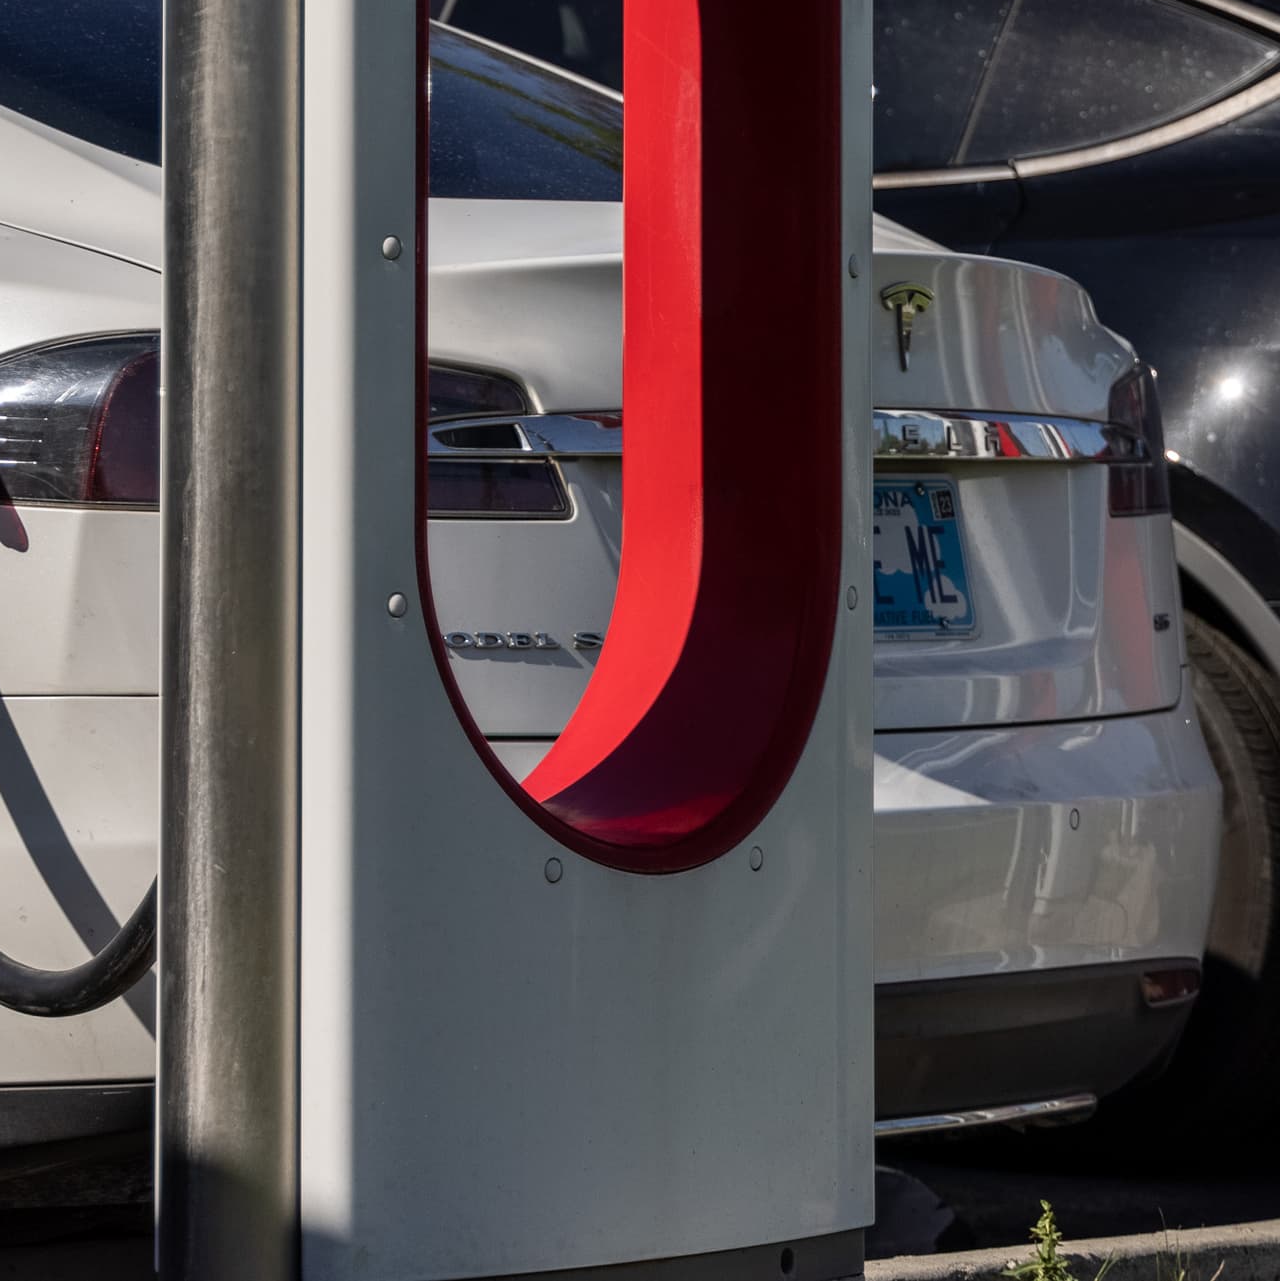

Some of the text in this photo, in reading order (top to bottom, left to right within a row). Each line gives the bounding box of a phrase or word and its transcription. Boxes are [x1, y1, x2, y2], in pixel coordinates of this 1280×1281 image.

[901, 424, 1001, 453] SLA
[905, 525, 959, 604] ME
[444, 630, 607, 650] ODEL S
